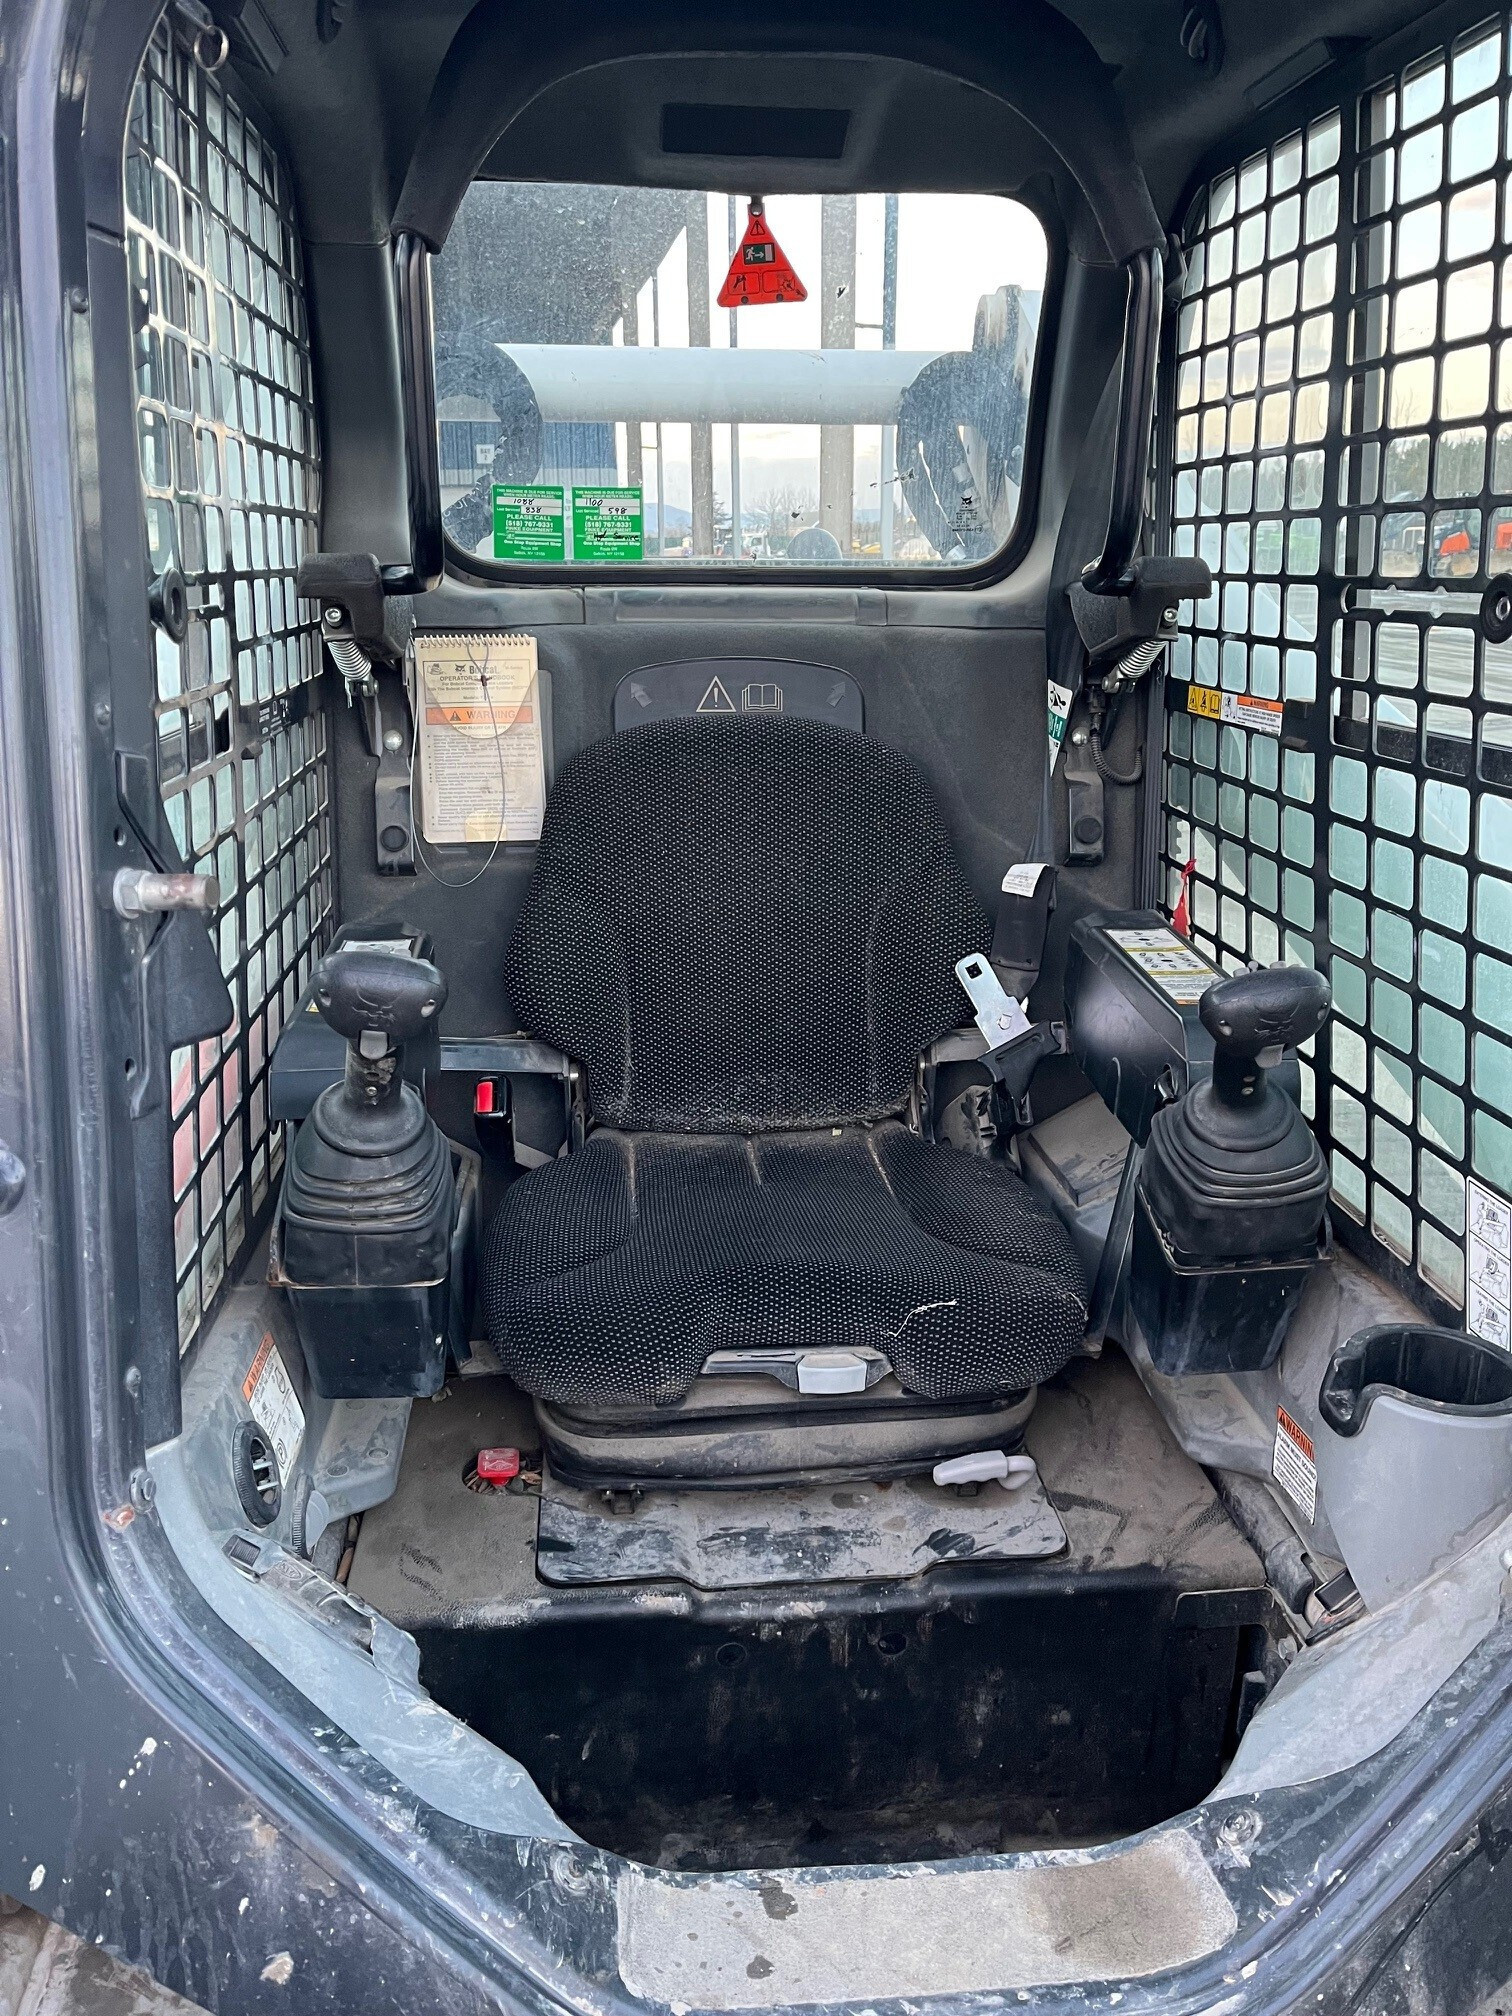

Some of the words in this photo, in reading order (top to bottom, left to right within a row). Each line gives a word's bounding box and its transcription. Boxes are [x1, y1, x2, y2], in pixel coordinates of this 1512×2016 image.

[513, 498, 535, 506] 1088
[585, 497, 603, 507] 1100
[525, 506, 542, 514] 838
[506, 513, 533, 521] PLEASE
[524, 520, 553, 528] 767-9331
[469, 665, 498, 675] Bocat
[1286, 1417, 1315, 1462] WARNIN
